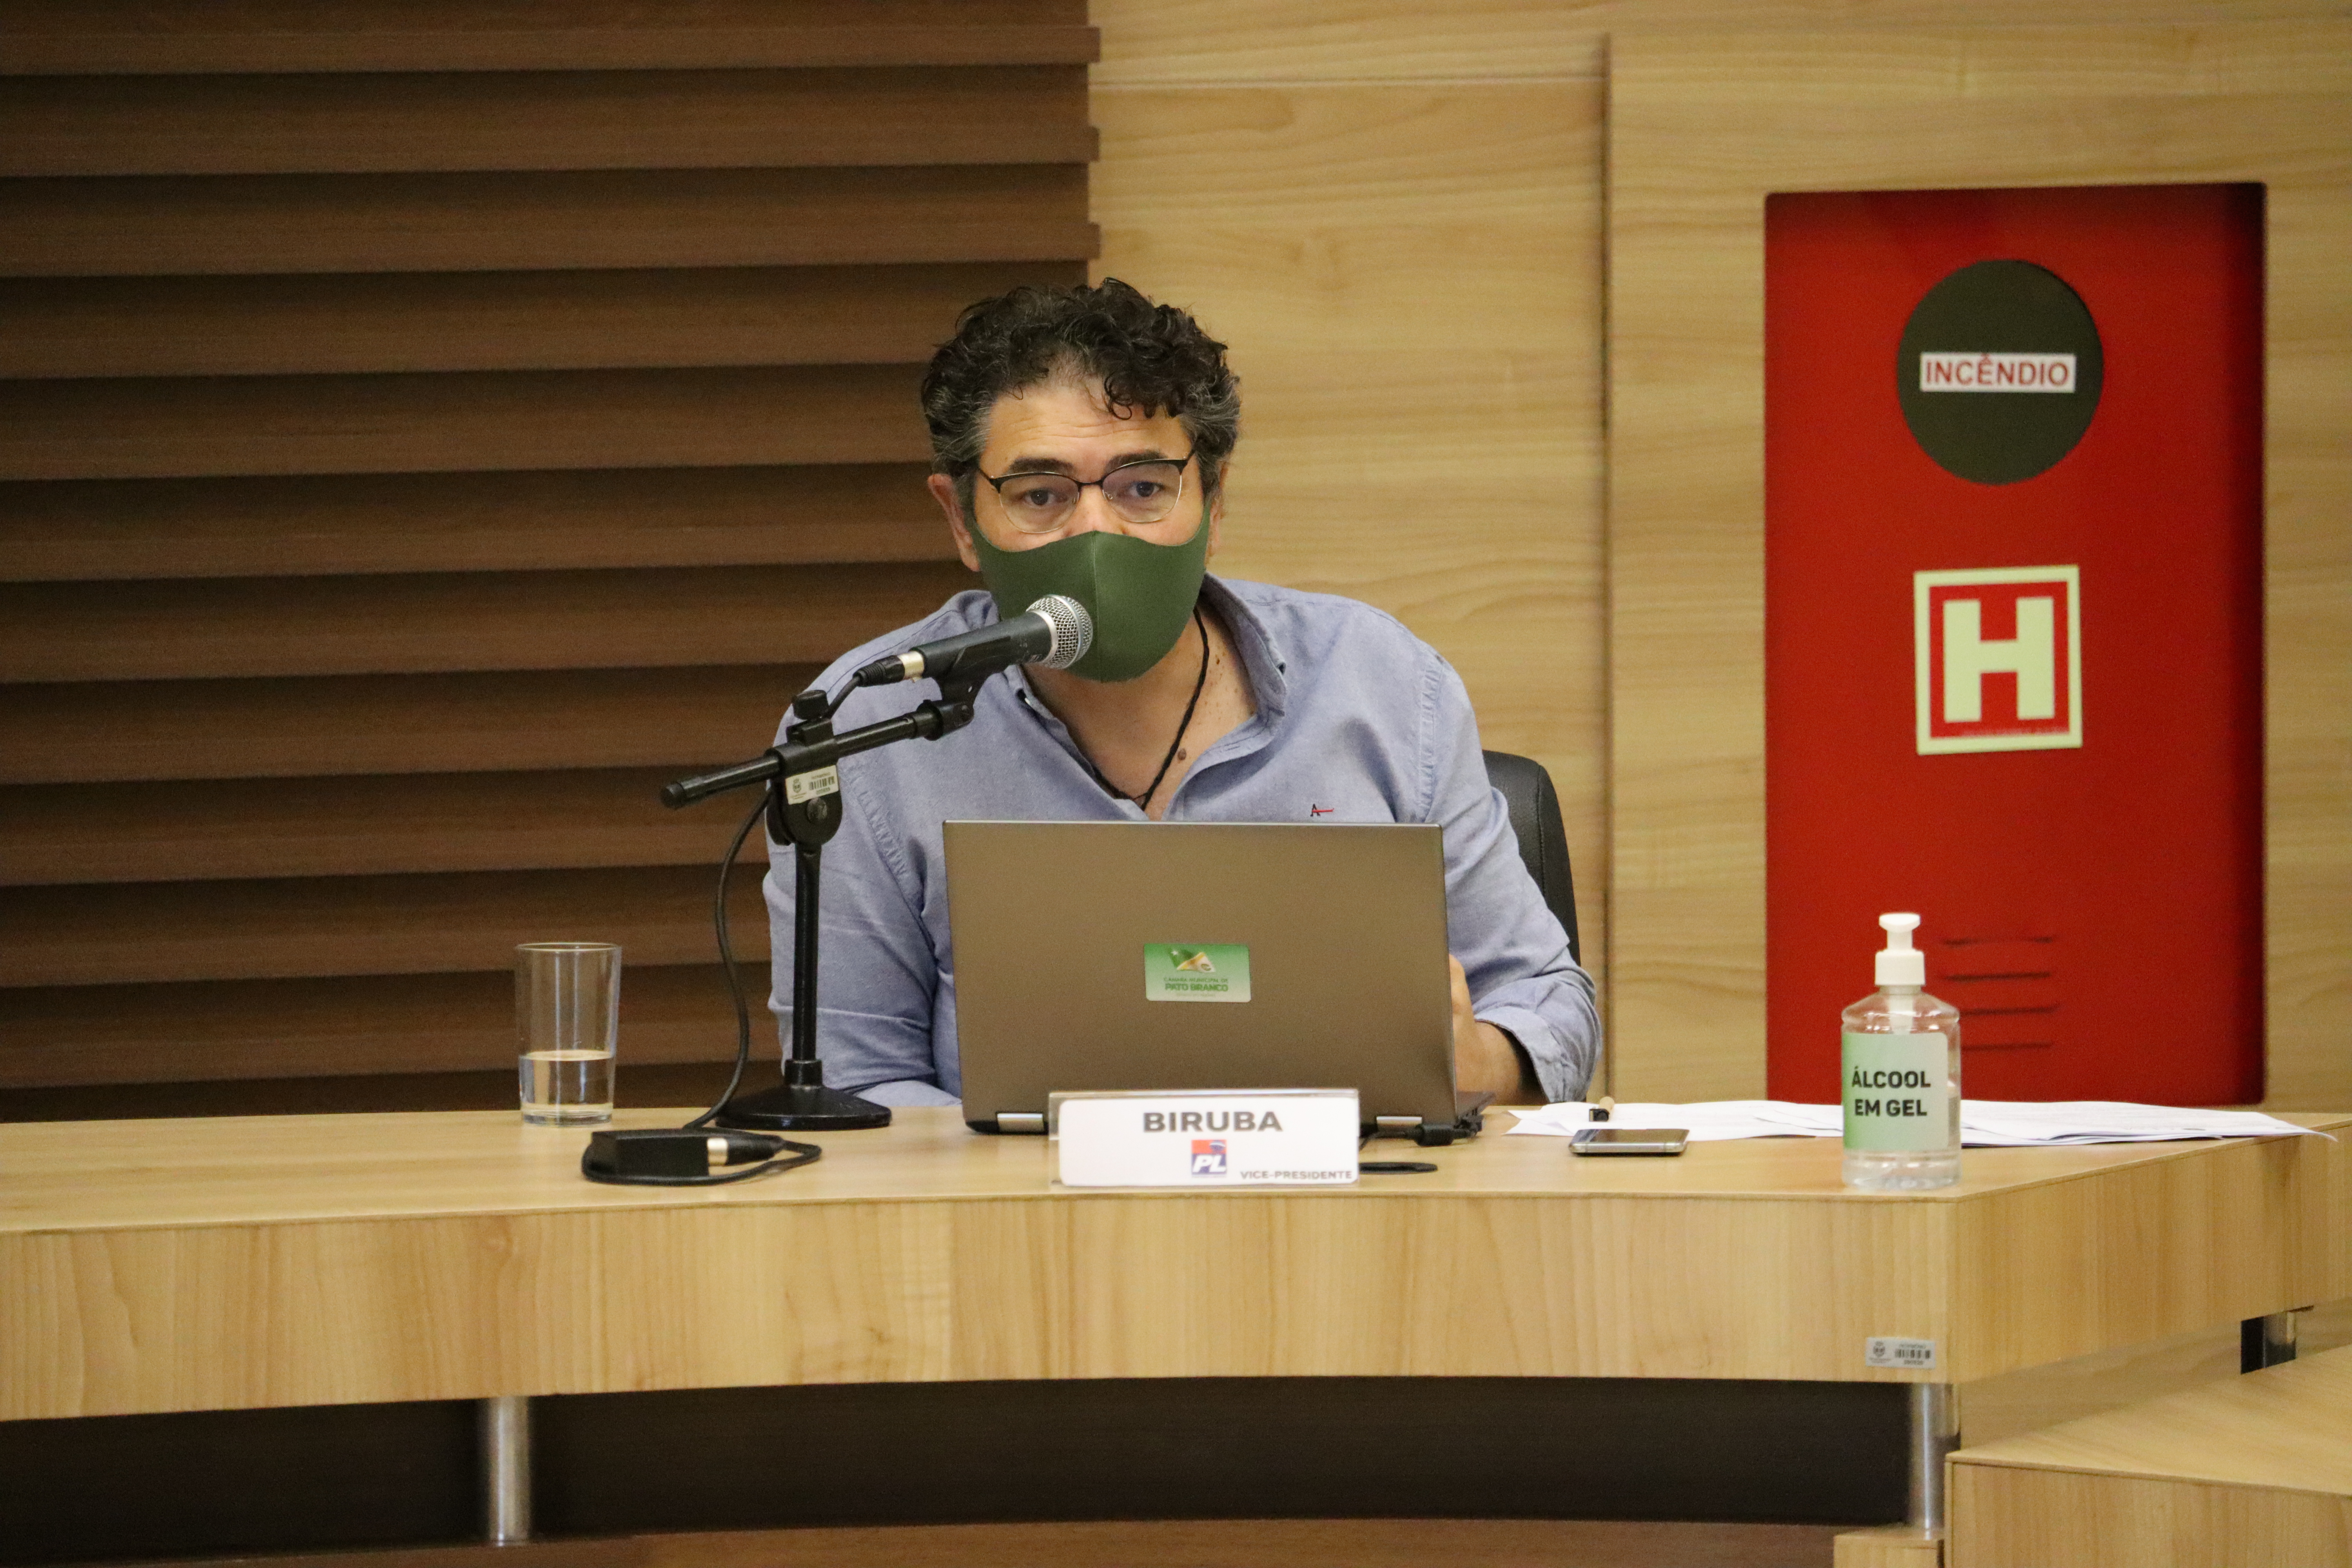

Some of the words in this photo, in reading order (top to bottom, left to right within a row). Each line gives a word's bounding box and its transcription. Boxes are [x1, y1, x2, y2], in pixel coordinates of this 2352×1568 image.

[1926, 354, 2069, 386] INCÊNDIO
[1943, 596, 2055, 723] H
[1190, 984, 1228, 992] BRANCO
[1851, 1066, 1931, 1088] ÁLCOOL
[1855, 1099, 1880, 1116] EM
[1886, 1099, 1927, 1117] GEL
[1143, 1111, 1283, 1132] BIRUBA
[1192, 1154, 1226, 1173] PL
[1240, 1170, 1352, 1180] VICE-PRESIDENTE
